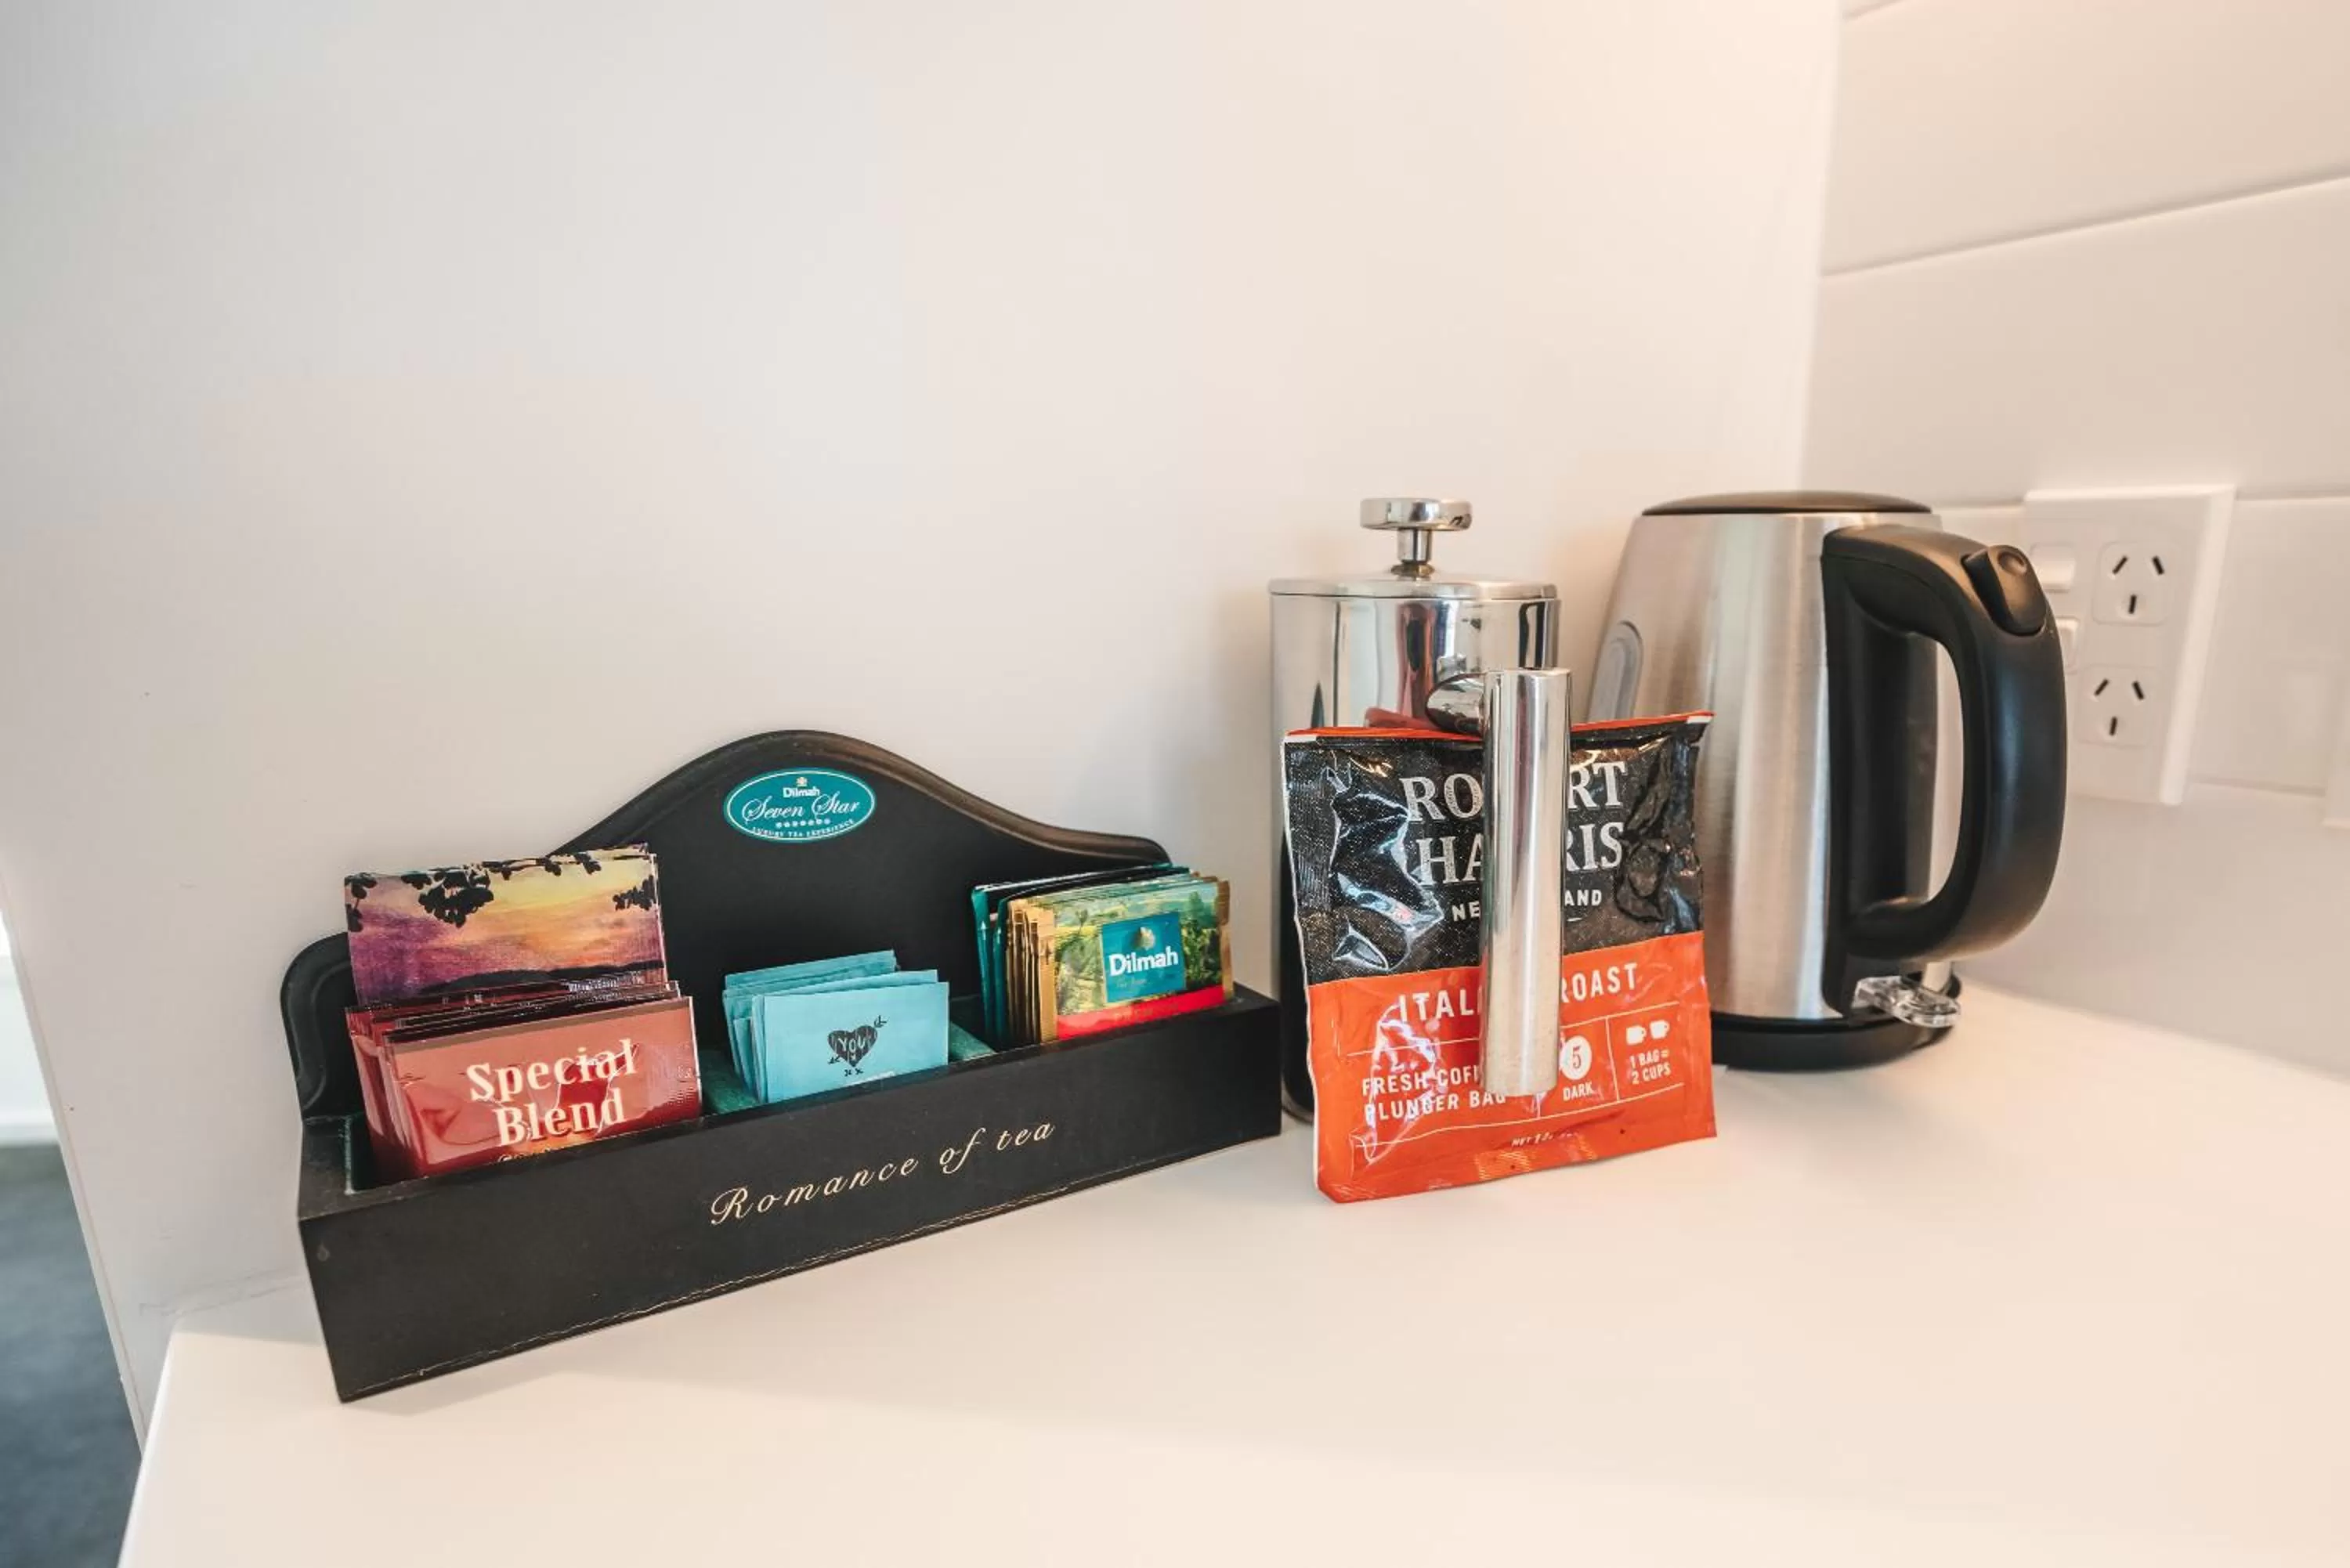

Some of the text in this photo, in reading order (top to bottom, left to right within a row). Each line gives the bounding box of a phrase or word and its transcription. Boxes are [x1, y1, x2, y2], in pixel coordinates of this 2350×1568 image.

[783, 786, 820, 798] Dilmah
[1398, 761, 1629, 822] RORT
[742, 791, 860, 824] Seven Star
[1415, 822, 1625, 887] HARIS
[1452, 901, 1480, 922] NE
[1108, 945, 1179, 976] Dilmah
[466, 1038, 638, 1101] Special
[1571, 1045, 1582, 1071] 5
[1630, 1055, 1636, 1068] 1
[1362, 1070, 1428, 1096] FRESH
[1632, 1063, 1671, 1085] 2 CUPS
[1563, 1081, 1593, 1101] DARK
[492, 1088, 626, 1147] Blend
[1364, 1093, 1459, 1121] PLUNGER
[710, 1120, 1056, 1226] Romance of tea
